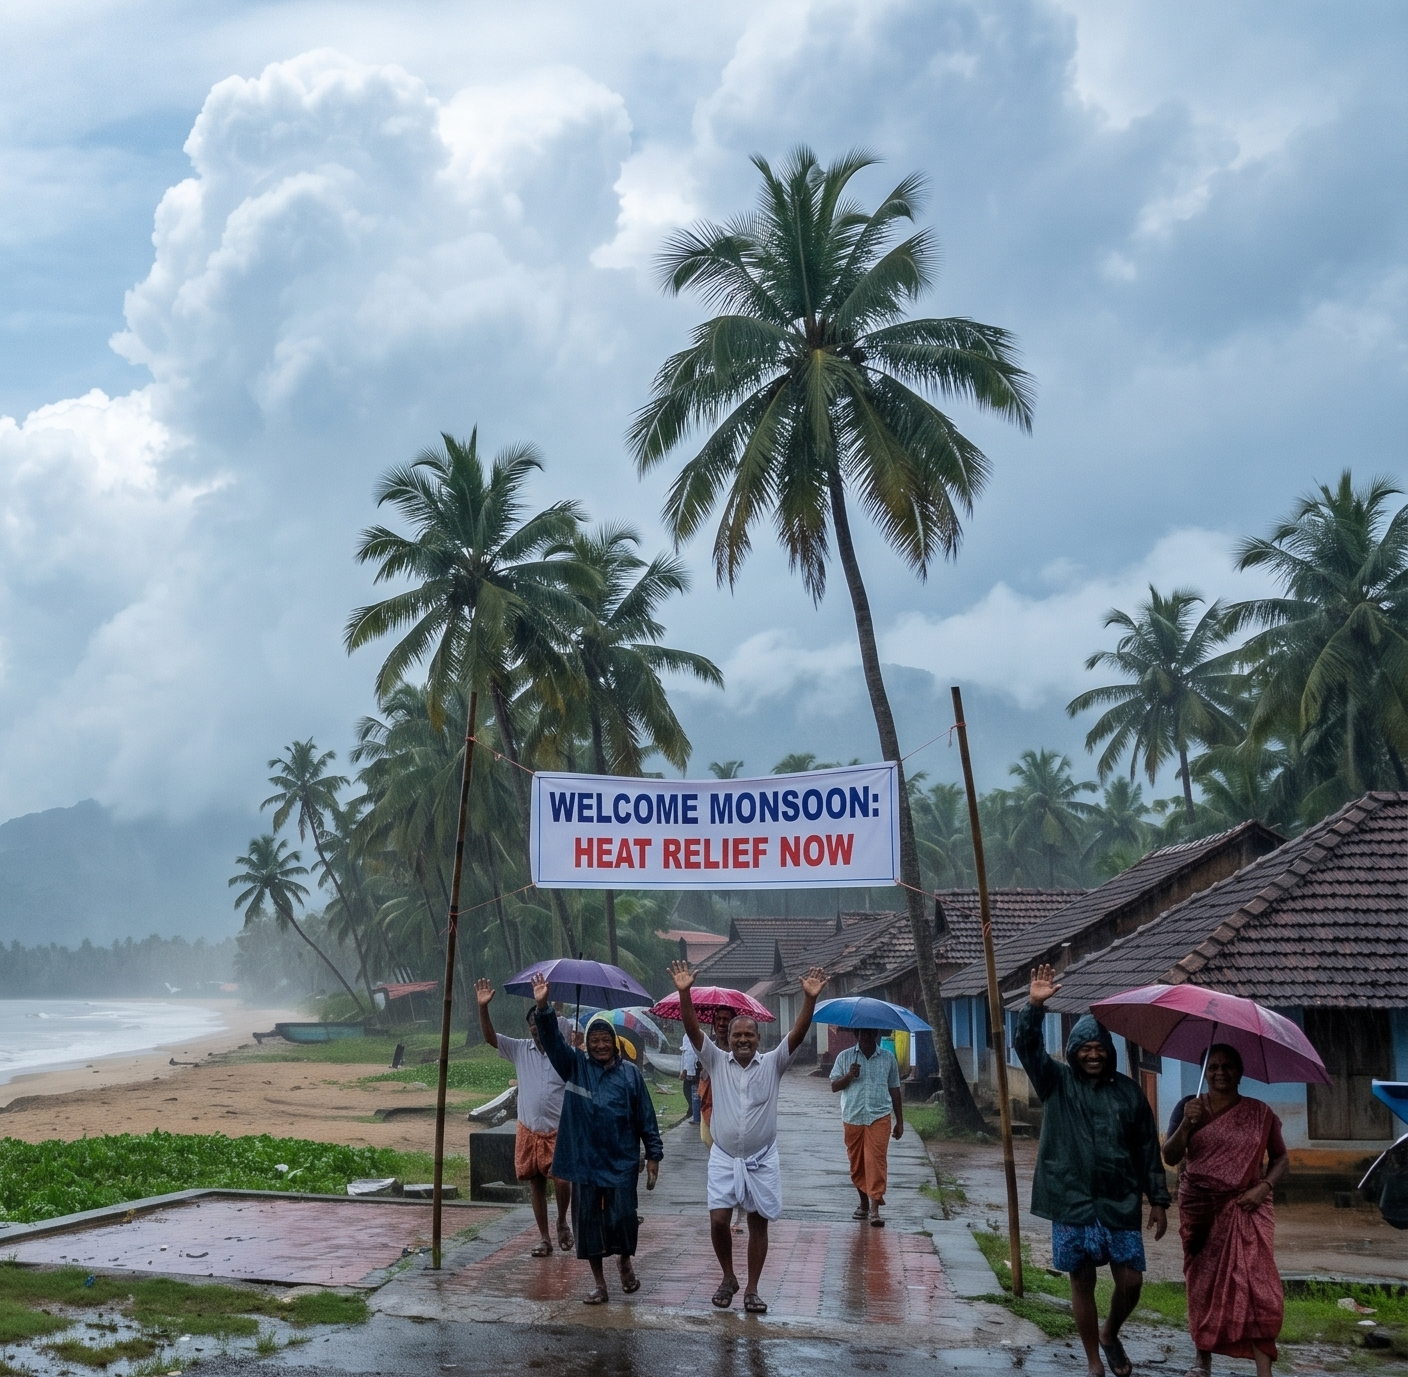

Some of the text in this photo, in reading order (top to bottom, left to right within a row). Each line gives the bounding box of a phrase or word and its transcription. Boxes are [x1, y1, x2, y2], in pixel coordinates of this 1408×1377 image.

[549, 785, 880, 826] WELCOME MONSOON:
[575, 834, 854, 869] HEAT RELIEF NOW
